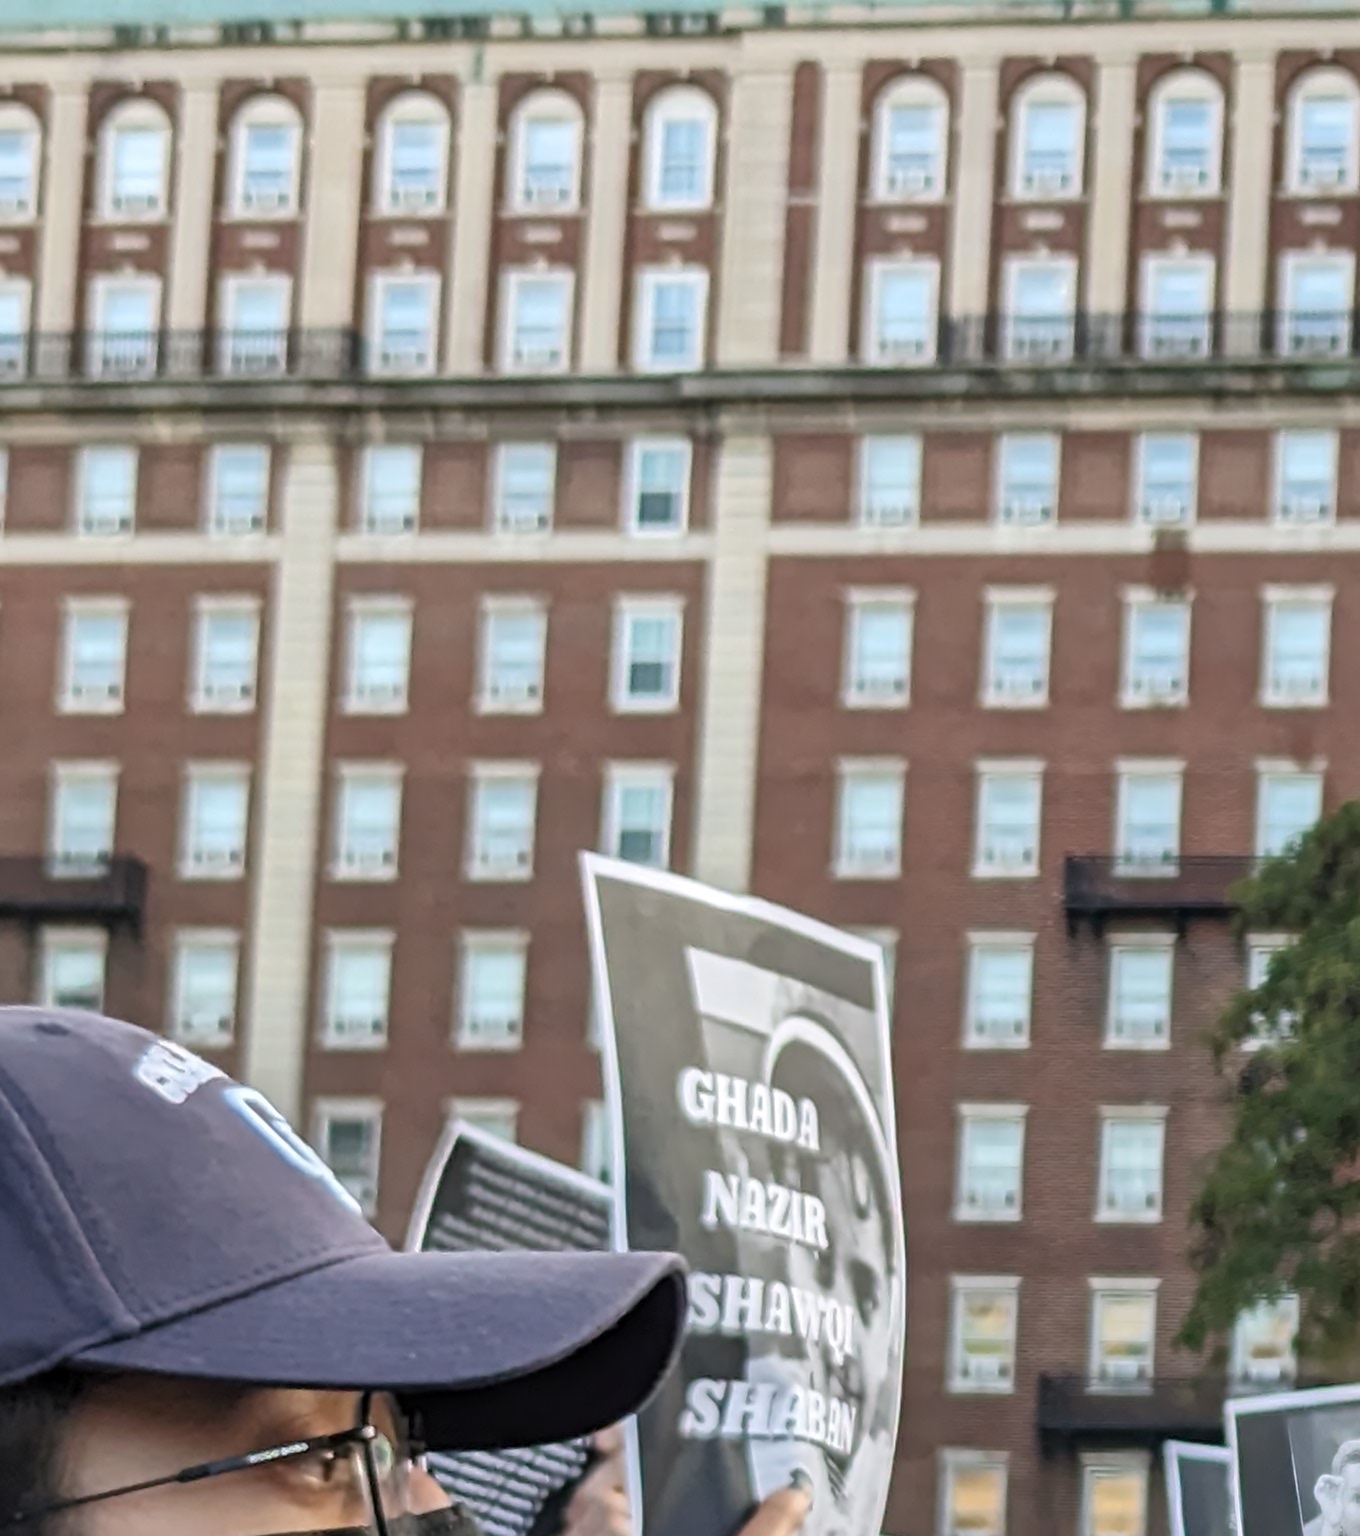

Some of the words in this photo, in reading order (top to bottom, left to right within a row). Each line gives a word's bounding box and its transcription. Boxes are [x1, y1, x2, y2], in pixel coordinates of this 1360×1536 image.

[680, 1066, 821, 1152] GHADA
[702, 1170, 829, 1250] NAZIR
[687, 1272, 855, 1366] SHAWQI
[680, 1377, 857, 1455] SHABAN
